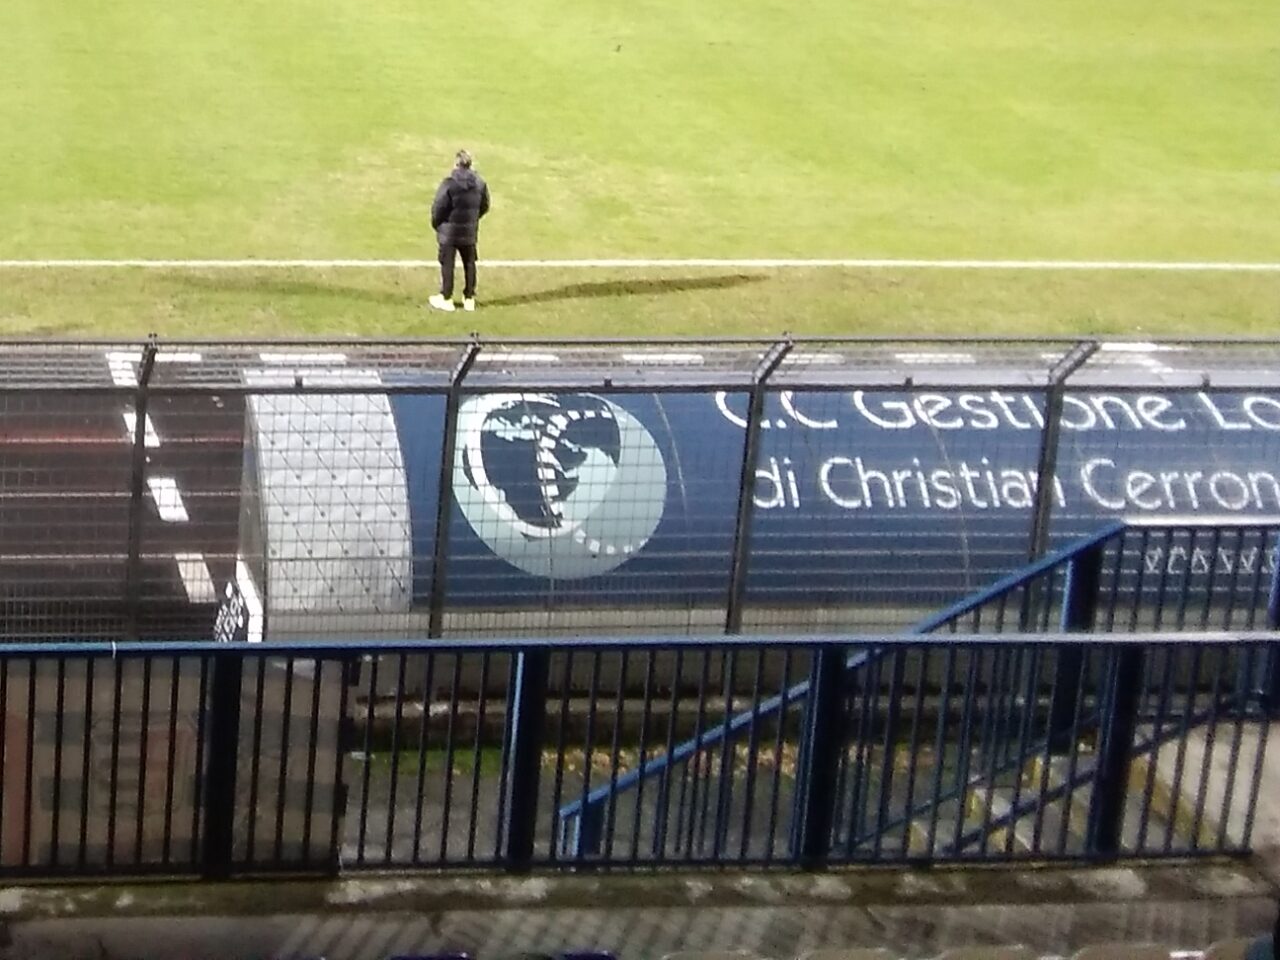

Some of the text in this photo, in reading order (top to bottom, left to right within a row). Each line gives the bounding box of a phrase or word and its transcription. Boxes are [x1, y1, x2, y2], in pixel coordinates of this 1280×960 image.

[853, 391, 1186, 429] Gestione
[752, 457, 800, 509] di
[820, 456, 1066, 510] Christian
